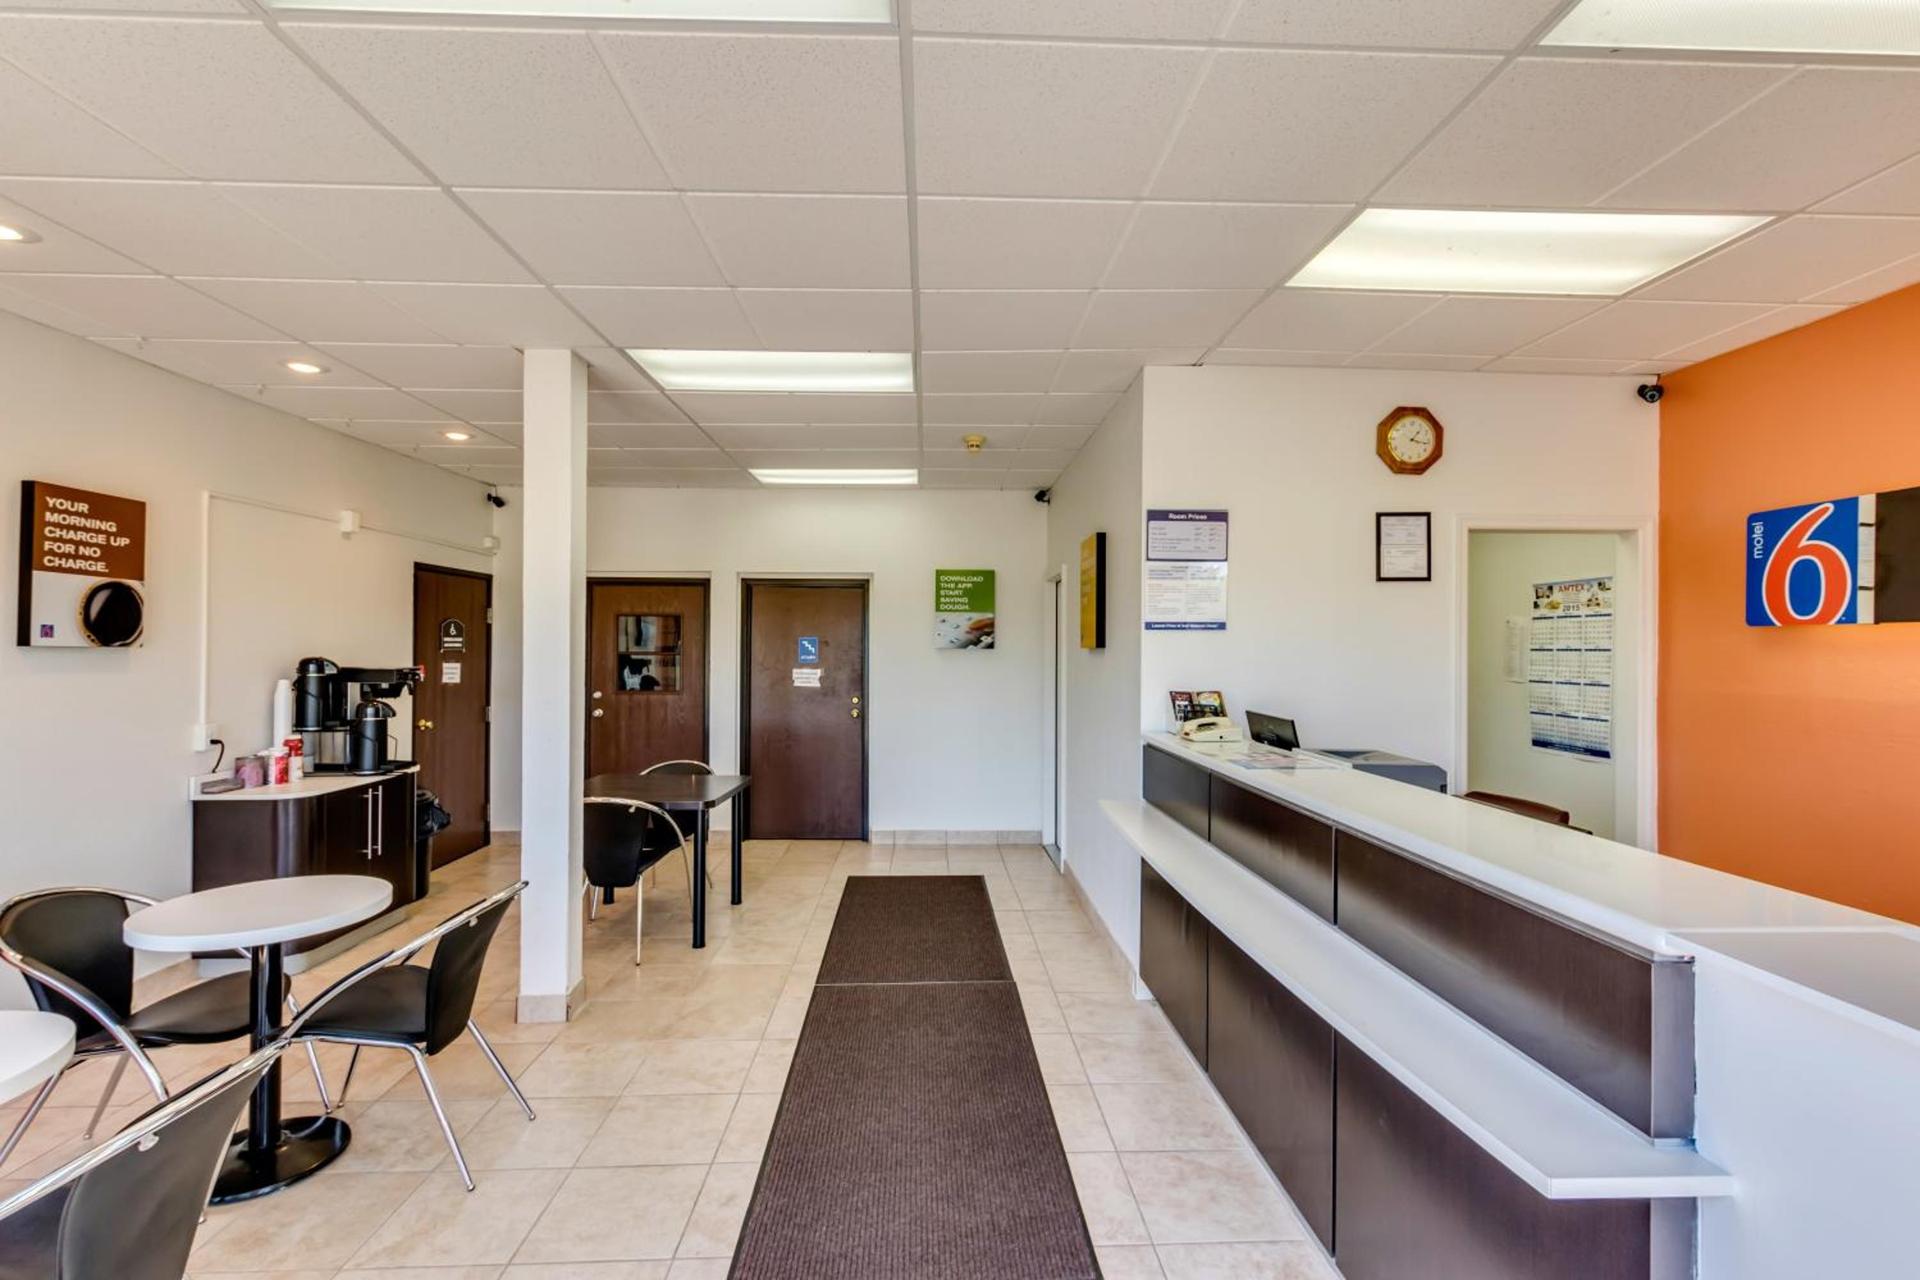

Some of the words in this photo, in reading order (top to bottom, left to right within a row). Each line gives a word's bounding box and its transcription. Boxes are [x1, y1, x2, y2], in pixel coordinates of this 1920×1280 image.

[44, 496, 89, 514] YOUR
[44, 512, 117, 532] MORNING
[44, 526, 107, 545] CHARGE
[110, 536, 130, 547] UP
[1752, 521, 1764, 559] motel
[44, 541, 76, 555] FOR
[78, 547, 101, 557] NO
[43, 555, 109, 572] CHARGE.
[1762, 502, 1852, 626] 6
